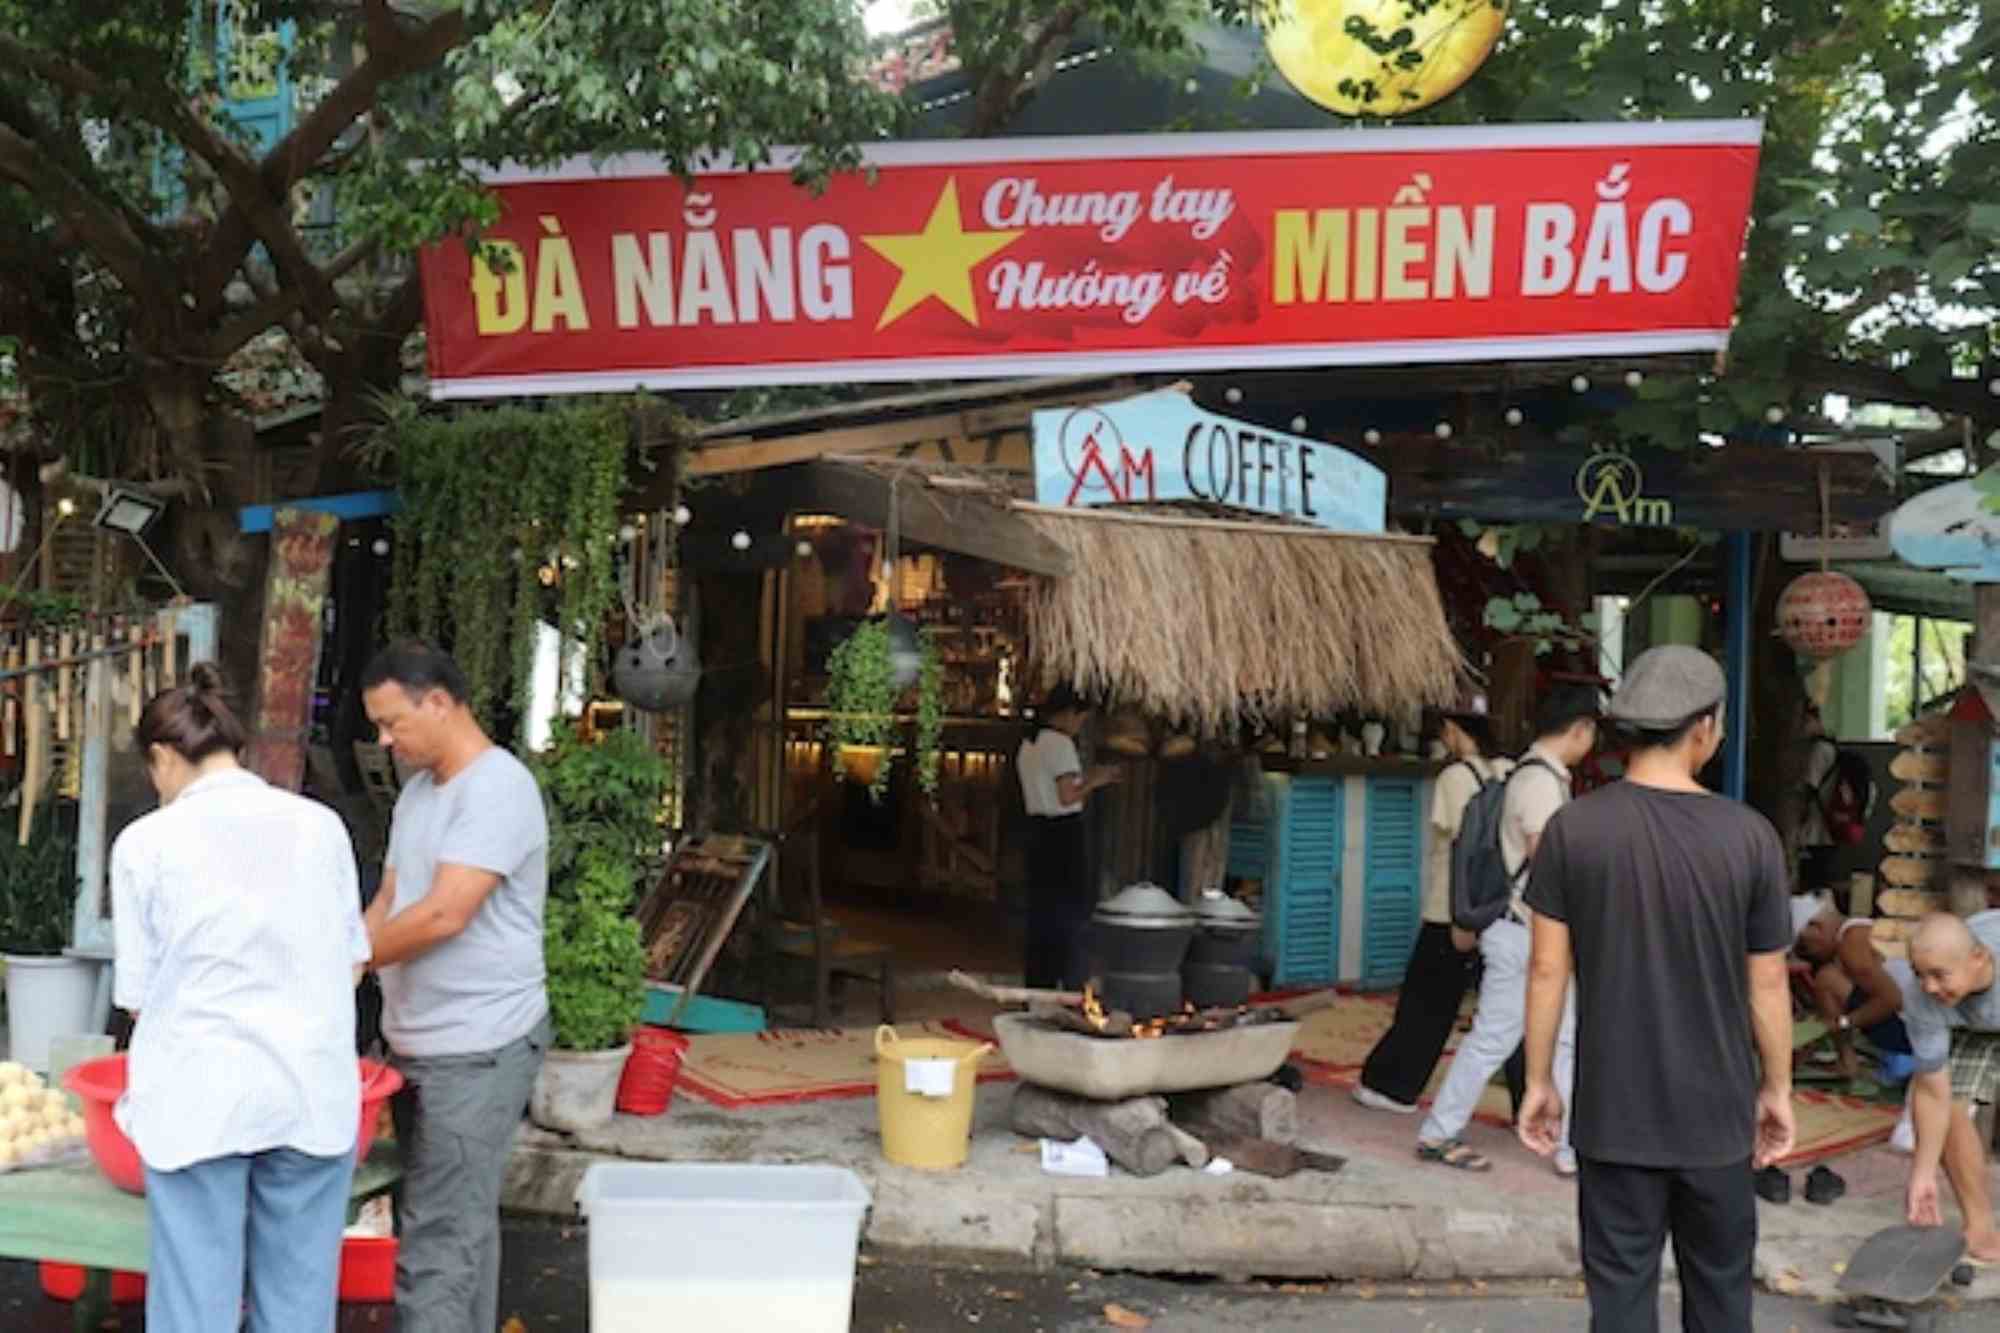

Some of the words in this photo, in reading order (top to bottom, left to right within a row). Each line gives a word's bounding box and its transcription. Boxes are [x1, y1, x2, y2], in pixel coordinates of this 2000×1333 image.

[983, 177, 1143, 242] Chung
[1149, 173, 1236, 240] tay
[1274, 172, 1497, 304] MIỀN
[1521, 163, 1692, 296] BẮC
[471, 215, 591, 336] ĐÀ
[612, 192, 853, 329] NẴNG
[988, 258, 1167, 323] Hướng
[1172, 248, 1233, 303] về
[1183, 422, 1318, 518] COFFEE
